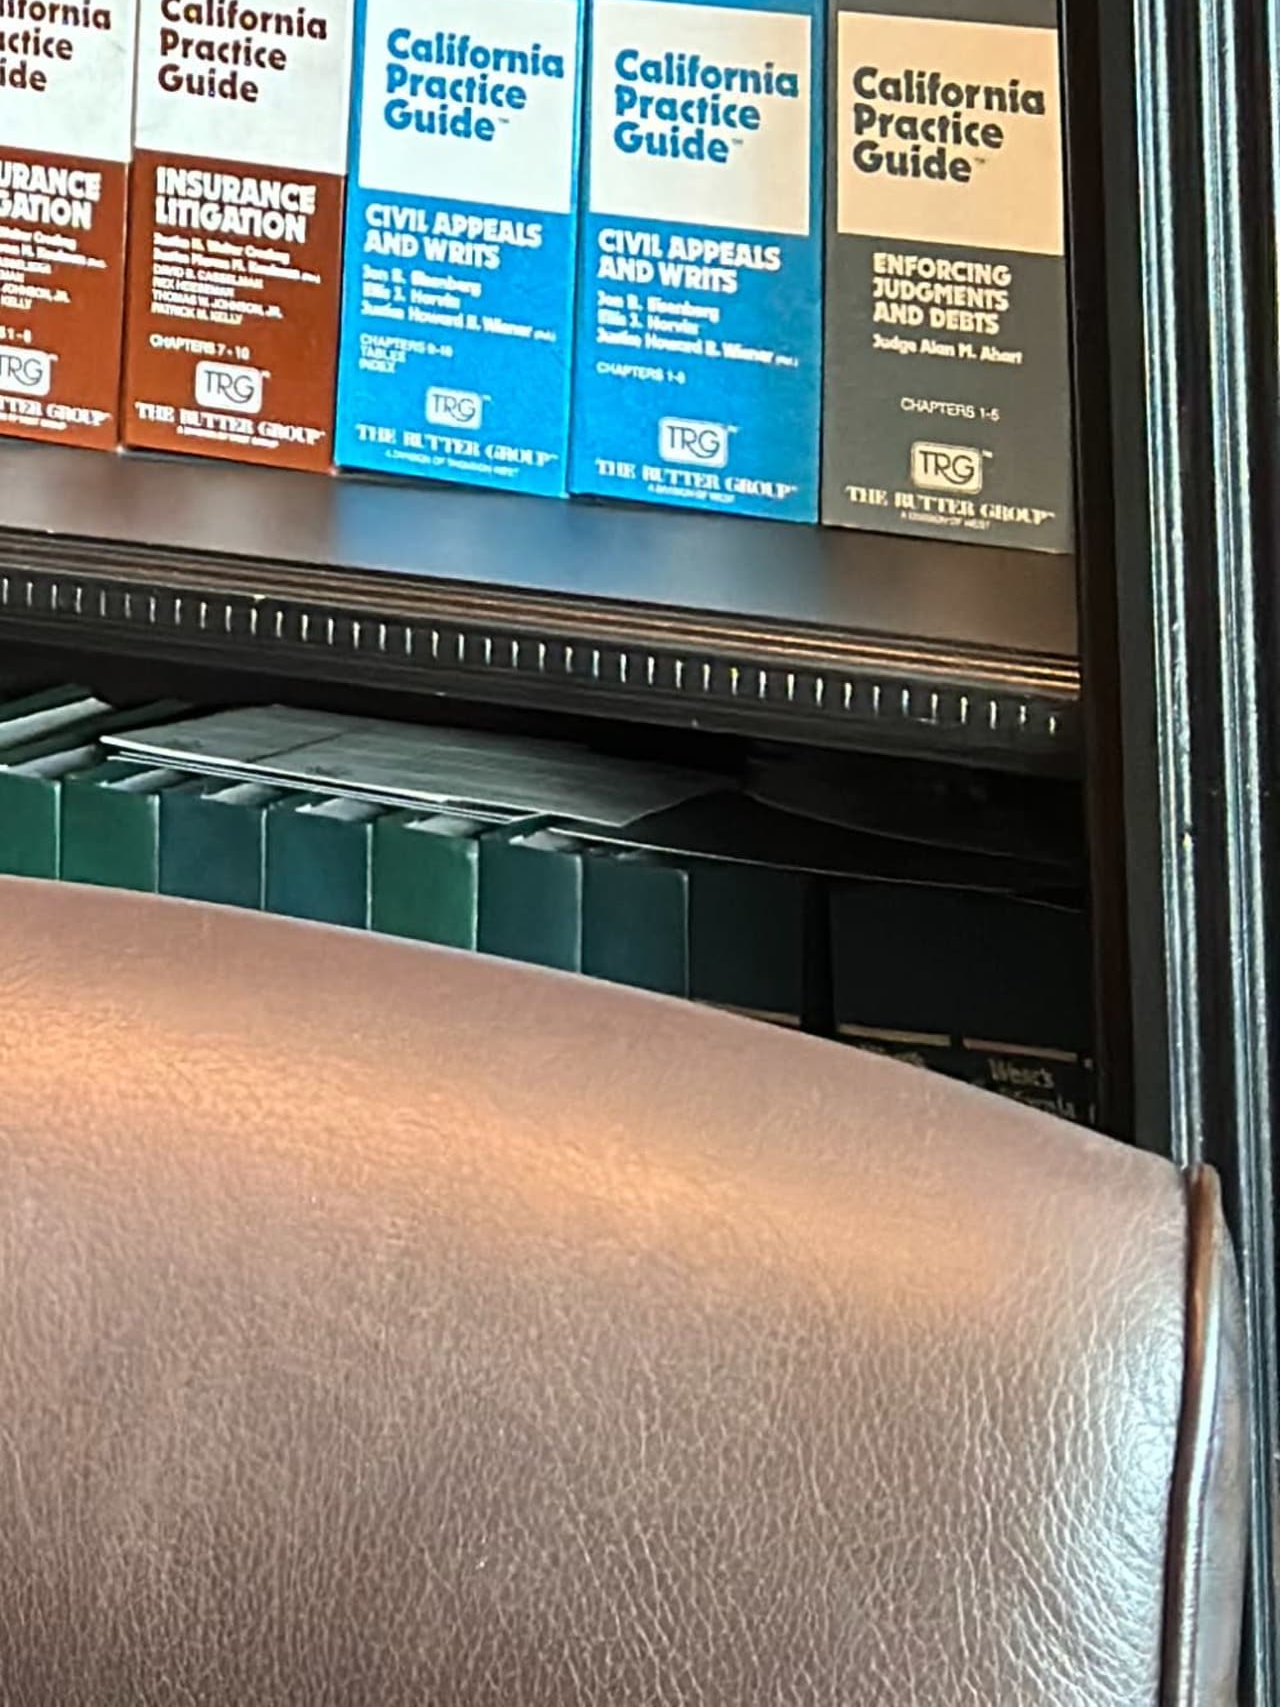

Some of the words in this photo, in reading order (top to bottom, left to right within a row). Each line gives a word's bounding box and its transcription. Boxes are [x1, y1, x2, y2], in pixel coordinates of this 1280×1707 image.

[160, 29, 287, 70] Practice
[386, 28, 565, 78] California
[159, 66, 259, 103] Guide
[386, 64, 527, 109] Practice
[615, 50, 799, 97] California
[853, 67, 1045, 115] California
[385, 99, 495, 141] Guide
[615, 85, 761, 130] Practice
[853, 104, 1004, 149] Practice
[614, 122, 729, 163] Guide
[853, 141, 972, 183] Guide
[156, 167, 317, 214] INSURANCE
[155, 197, 306, 243] LITIGATION
[366, 204, 429, 233] CIVIL
[432, 213, 543, 248] APPEALS
[364, 229, 419, 258] AND
[423, 236, 501, 269] WRITS
[598, 229, 662, 260] CIVIL
[667, 237, 780, 271] APPEALS
[873, 253, 1011, 286] ENFORCING
[598, 254, 653, 283] AND
[656, 263, 738, 294] WRITS
[872, 277, 1009, 311] JUDGMENTS
[872, 302, 924, 326] AND
[930, 309, 1000, 335] DEBTS
[872, 334, 917, 354] Judge
[980, 347, 1022, 365] Ahart
[205, 371, 255, 403] TRG
[432, 394, 476, 422] TRG
[901, 398, 974, 419] CHAPTERS
[667, 425, 721, 459] TRG
[919, 450, 975, 485] TRG
[845, 486, 888, 507] THE
